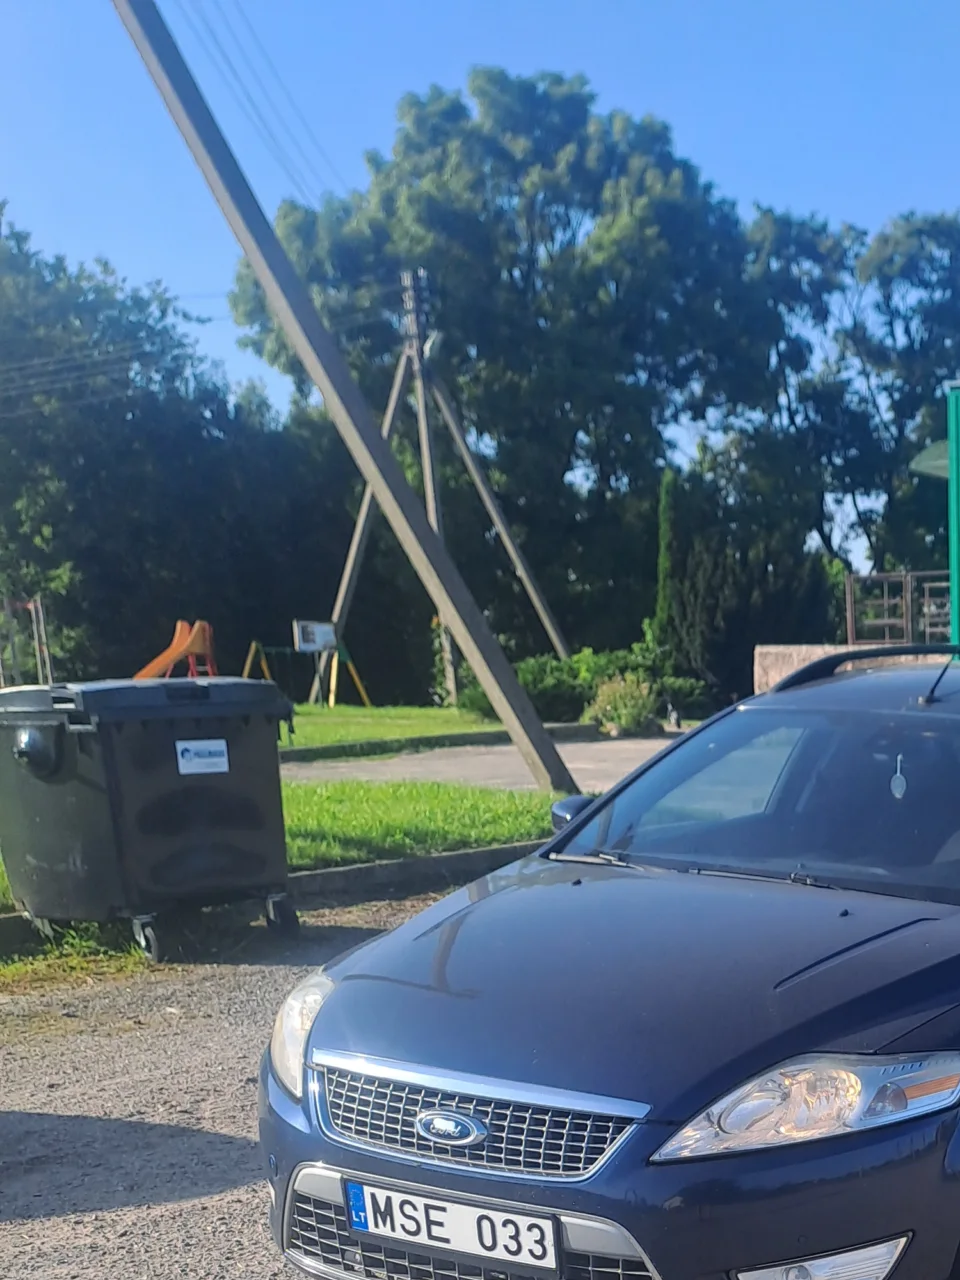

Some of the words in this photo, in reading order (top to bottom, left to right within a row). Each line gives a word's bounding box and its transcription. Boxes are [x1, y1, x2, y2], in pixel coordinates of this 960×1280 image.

[352, 1210, 366, 1223] LT
[370, 1191, 451, 1244] MSE
[476, 1213, 547, 1261] 033
